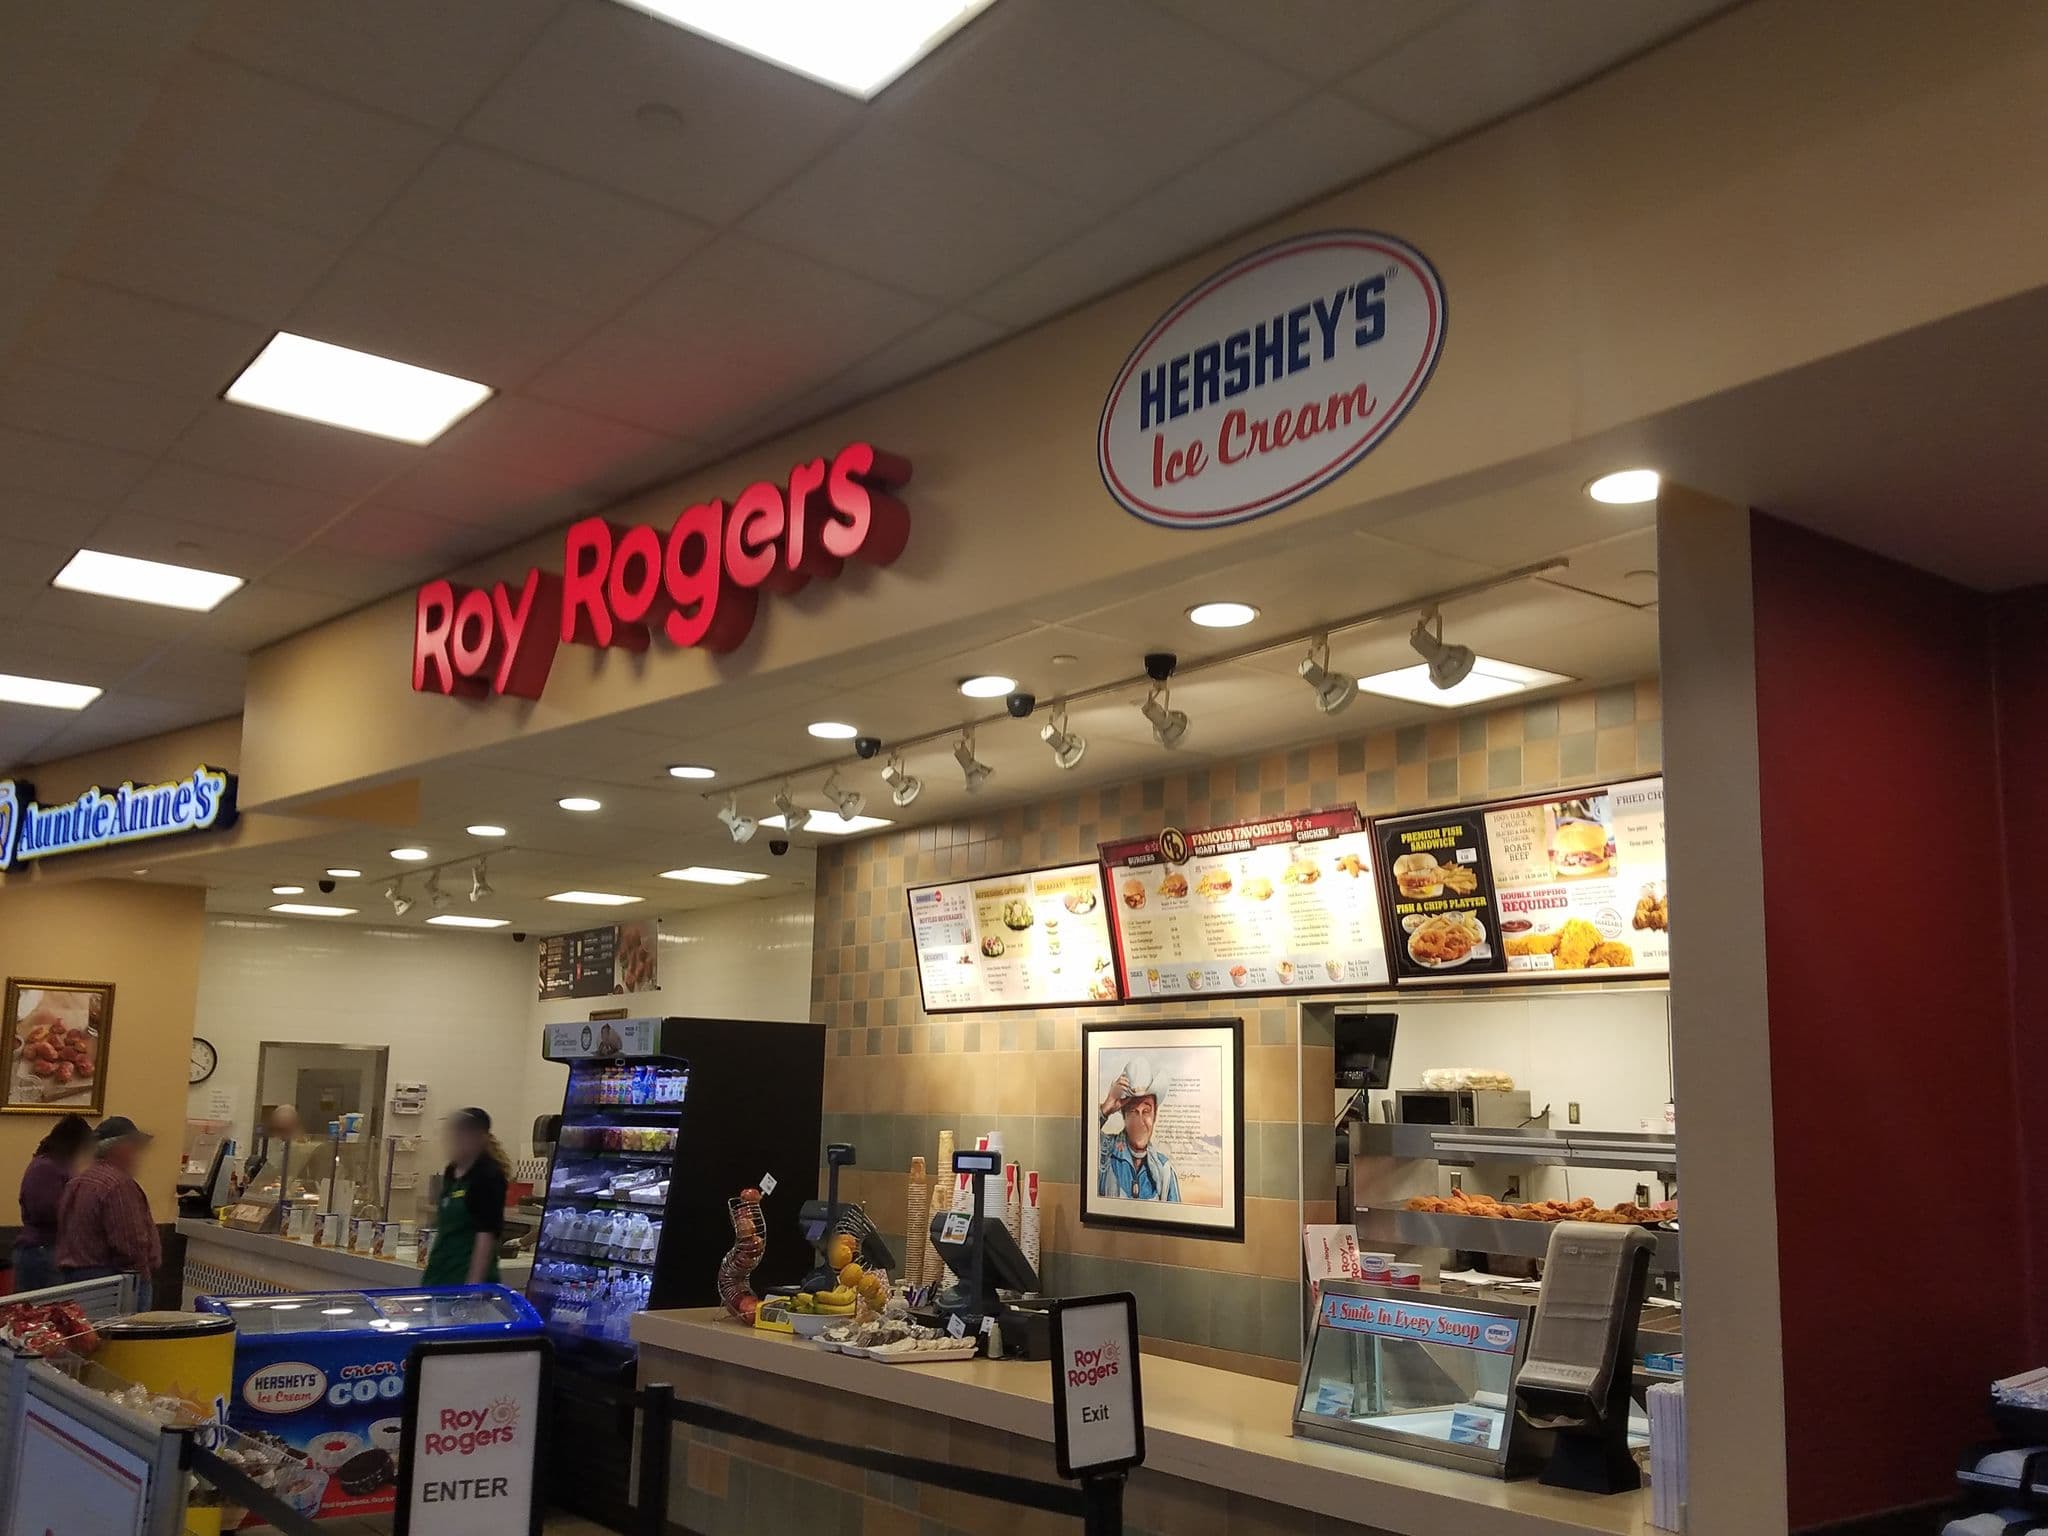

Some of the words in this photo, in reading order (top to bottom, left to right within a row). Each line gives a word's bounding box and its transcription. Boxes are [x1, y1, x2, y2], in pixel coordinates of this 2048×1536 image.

[1140, 273, 1386, 432] HERSHEY'S
[1152, 432, 1209, 488] Ice
[1218, 382, 1377, 466] Cream
[413, 567, 540, 695] Roy
[561, 441, 874, 648] Rogers
[1616, 792, 1645, 805] FRIED
[1191, 829, 1233, 846] FAMOUS
[1234, 820, 1293, 840] FAVORITES
[1401, 829, 1440, 844] PREMIUM
[1441, 826, 1463, 838] FISH
[1128, 854, 1155, 866] BURGERS
[1297, 827, 1329, 840] CHICKEN
[1410, 837, 1456, 852] SANDWICH
[1504, 842, 1532, 853] ROAST
[1509, 851, 1529, 862] BEEF
[1500, 890, 1532, 900] DOUBLE
[1533, 888, 1567, 899] DIPPING
[1396, 903, 1415, 914] FISH
[1423, 899, 1448, 910] CHIPS
[1449, 896, 1488, 909] PLATTER
[1502, 897, 1569, 913] REQUIRED
[1325, 1301, 1337, 1318] A
[1340, 1302, 1374, 1324] Smile
[1376, 1307, 1392, 1326] In
[1394, 1309, 1434, 1337] Every
[1436, 1316, 1481, 1345] Scoop
[1074, 1348, 1102, 1367] Roy
[254, 1373, 317, 1391] HERSHEY'S
[1068, 1361, 1119, 1388] Rogers
[440, 1408, 489, 1431] Roy
[1082, 1404, 1110, 1424] Exit
[425, 1426, 514, 1455] Rogers
[423, 1477, 509, 1503] ENTER
